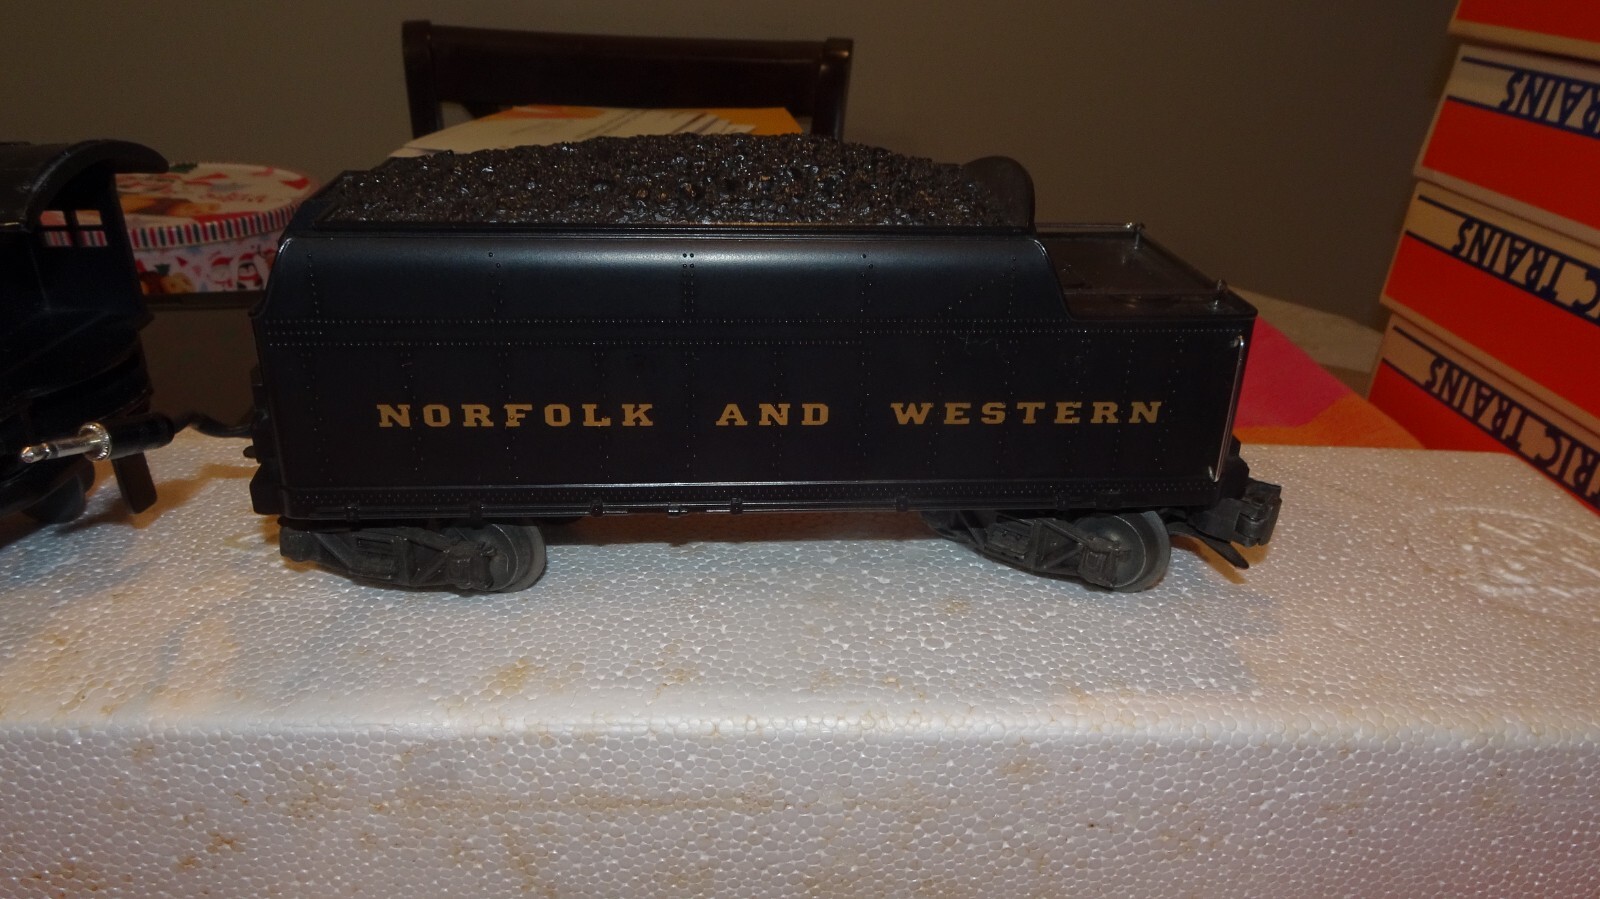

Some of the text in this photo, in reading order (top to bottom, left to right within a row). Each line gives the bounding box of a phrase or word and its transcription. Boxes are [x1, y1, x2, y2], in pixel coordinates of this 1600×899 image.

[1451, 217, 1563, 302] TRAINS
[376, 402, 1163, 428] NORFOLK AND WESTERN
[1424, 356, 1600, 509] RIC TRAINS
